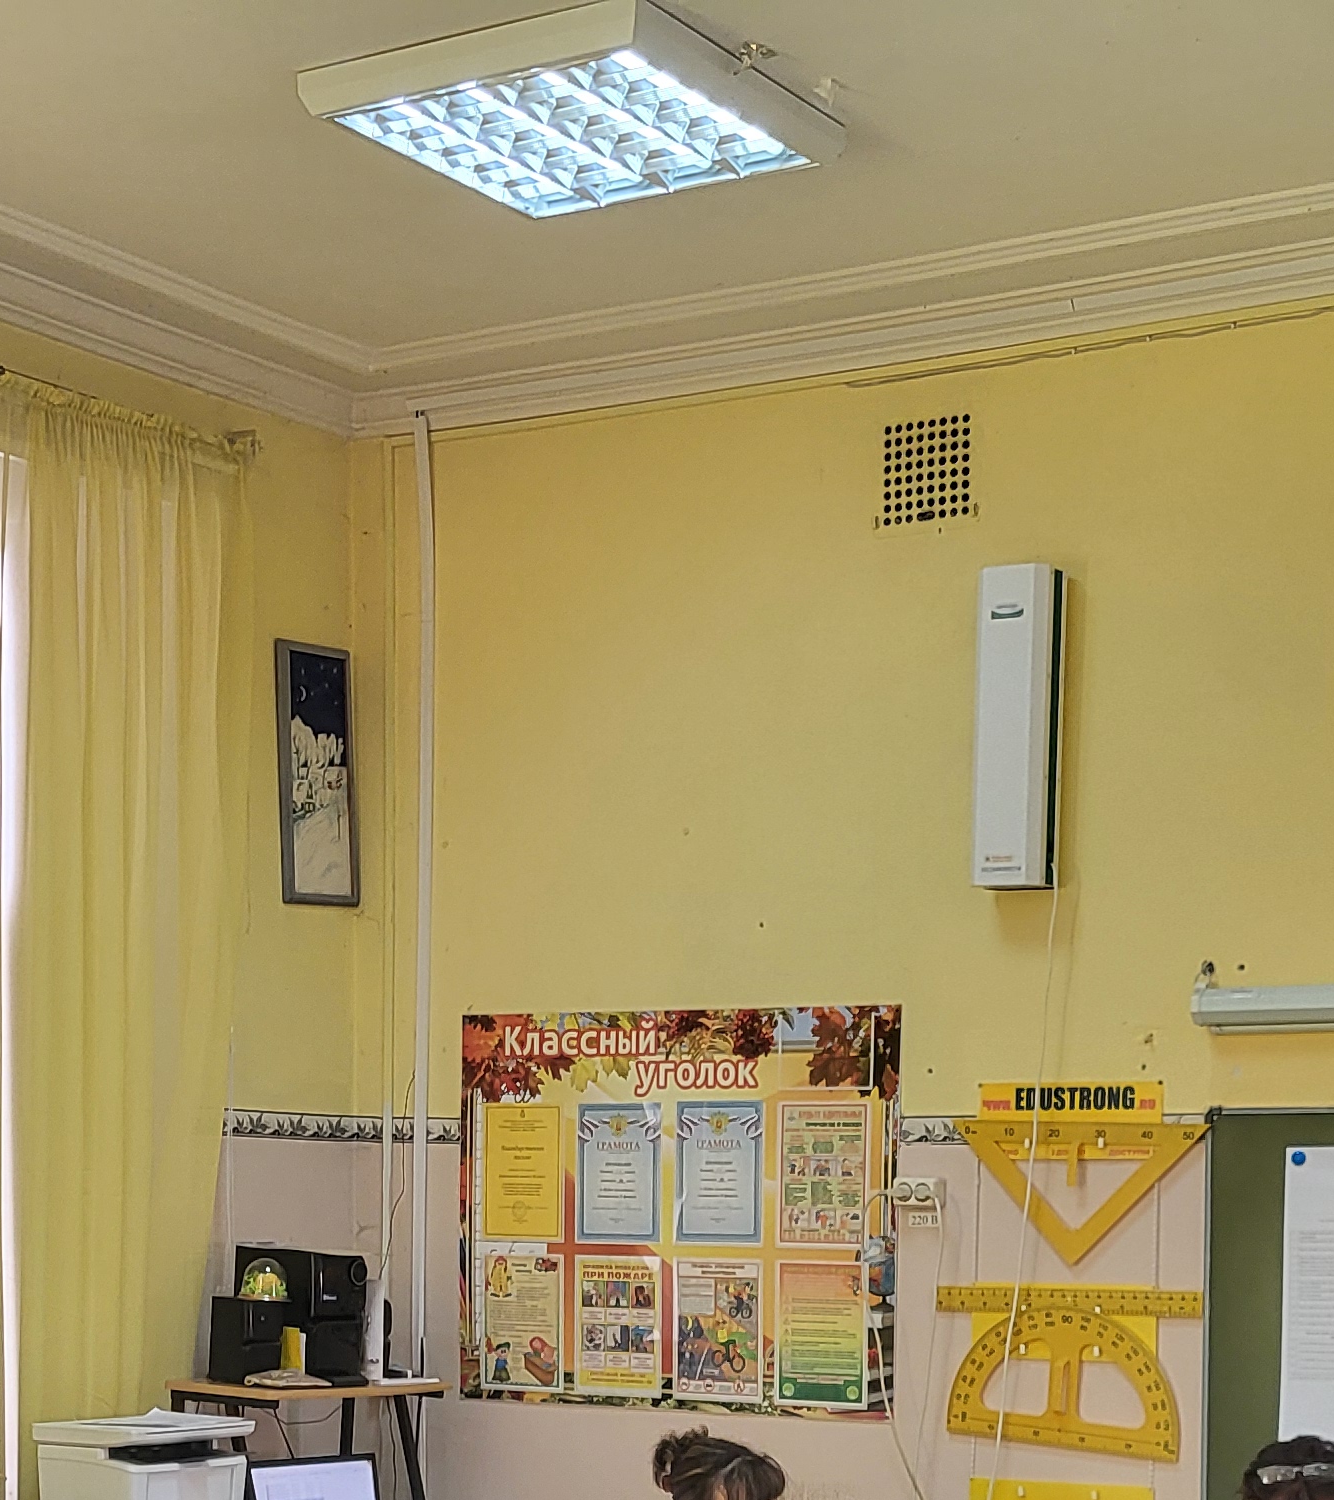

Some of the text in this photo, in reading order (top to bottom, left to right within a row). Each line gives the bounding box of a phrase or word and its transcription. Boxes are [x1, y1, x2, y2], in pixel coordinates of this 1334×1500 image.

[504, 1019, 658, 1057] Классный
[635, 1059, 759, 1097] уголок
[1015, 1086, 1135, 1112] EDUSTRONG
[1004, 1127, 1015, 1137] 10
[1048, 1128, 1060, 1138] 20
[1141, 1131, 1153, 1140] 40
[1182, 1131, 1195, 1141] 50
[596, 1140, 641, 1150] ГРАМОТА
[696, 1138, 742, 1149] ГРАМОТА
[910, 1214, 929, 1226] 220
[582, 1271, 654, 1281] ПРИ ПОЖАРЕ
